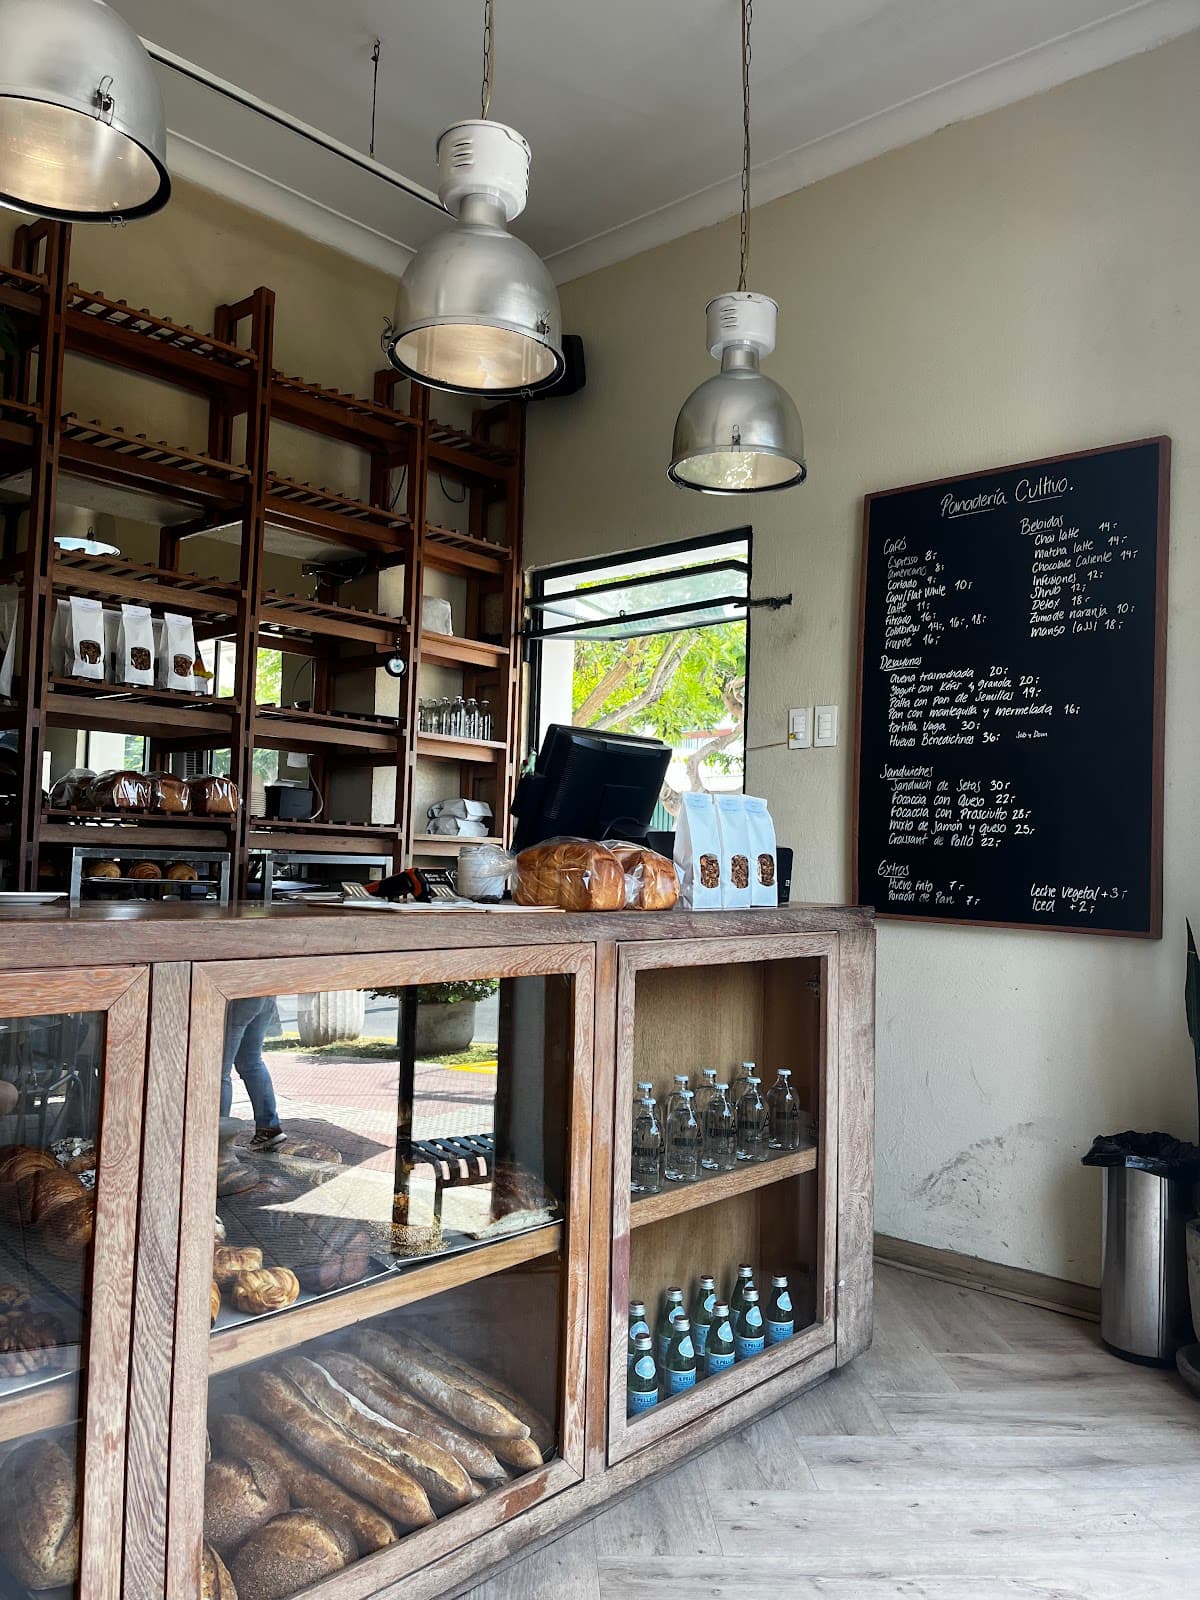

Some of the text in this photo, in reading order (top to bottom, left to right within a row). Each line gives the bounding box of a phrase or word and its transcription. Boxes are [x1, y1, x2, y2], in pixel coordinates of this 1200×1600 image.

[940, 488, 1007, 517] Panadería
[1020, 515, 1064, 535] Bebidas
[888, 579, 917, 590] Cortado
[1032, 572, 1076, 586] Infusiones
[1030, 585, 1061, 599] Shrub
[1032, 598, 1060, 610] Detox
[1069, 604, 1108, 619] naranja
[918, 685, 933, 693] con
[914, 698, 928, 707] con
[955, 692, 968, 702] de
[907, 710, 923, 718] con
[983, 708, 989, 719] y
[937, 780, 949, 791] de
[934, 794, 950, 806] con
[935, 807, 952, 819] con
[918, 820, 928, 831] de
[969, 825, 975, 836] y
[934, 835, 944, 846] de
[878, 860, 909, 876] Extras
[935, 891, 955, 904] Pan
